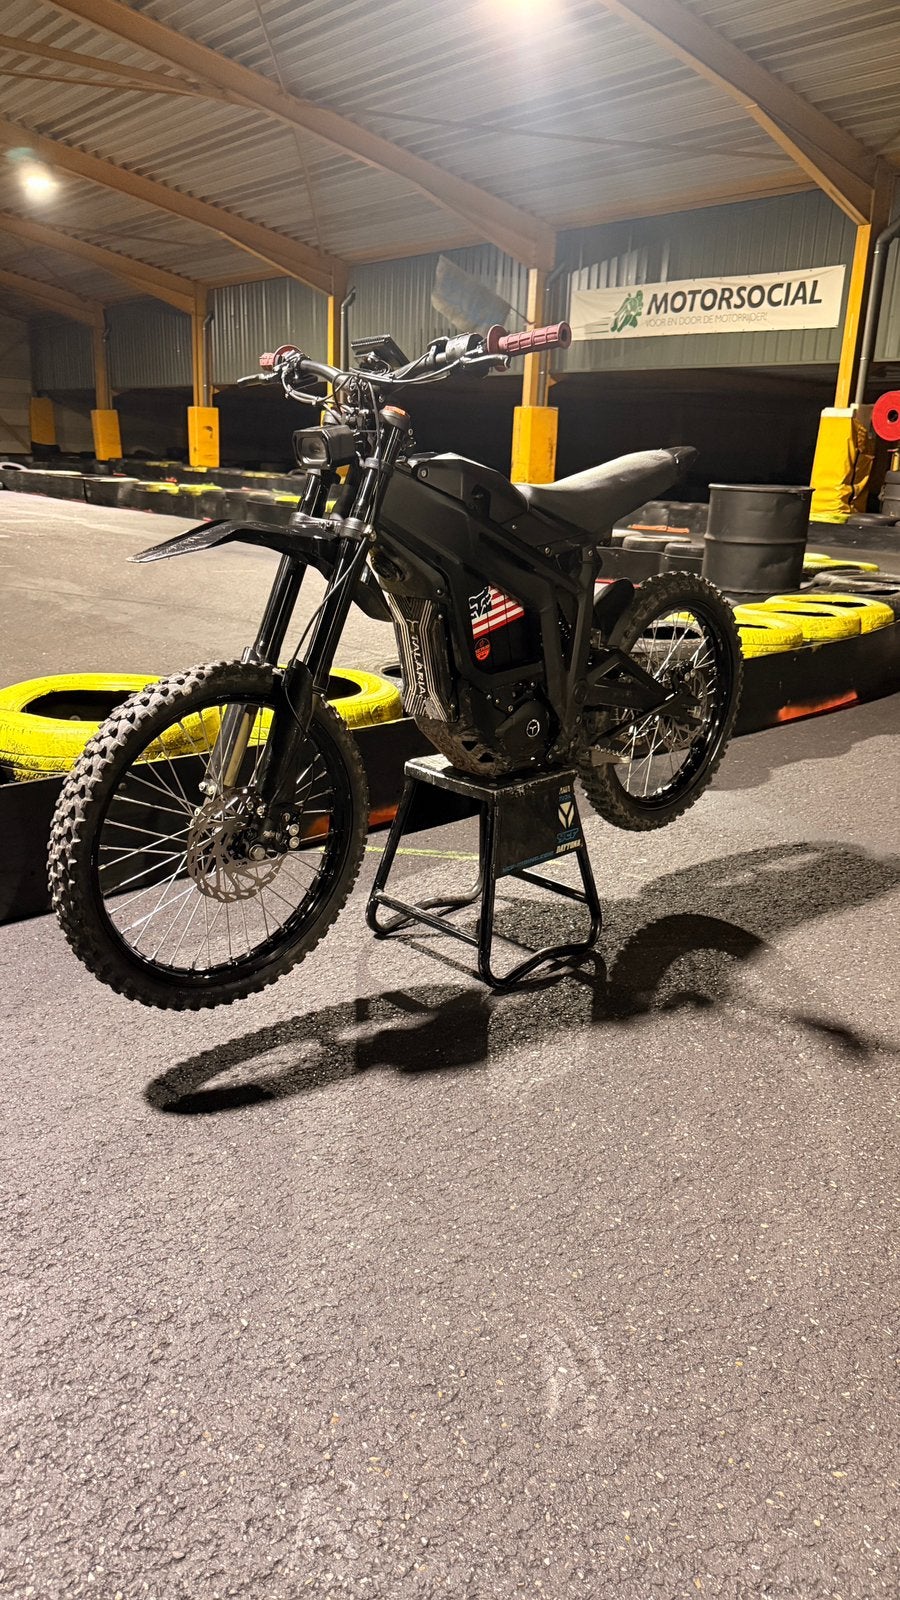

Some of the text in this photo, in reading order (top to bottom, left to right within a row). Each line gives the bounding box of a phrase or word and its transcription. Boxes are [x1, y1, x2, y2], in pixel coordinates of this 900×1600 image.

[647, 280, 822, 315] MOTORSOCIAL
[646, 317, 667, 327] VOOR
[668, 317, 678, 327] EN
[679, 315, 702, 327] DOOR
[703, 315, 713, 325] DE
[411, 635, 426, 694] TALARIA
